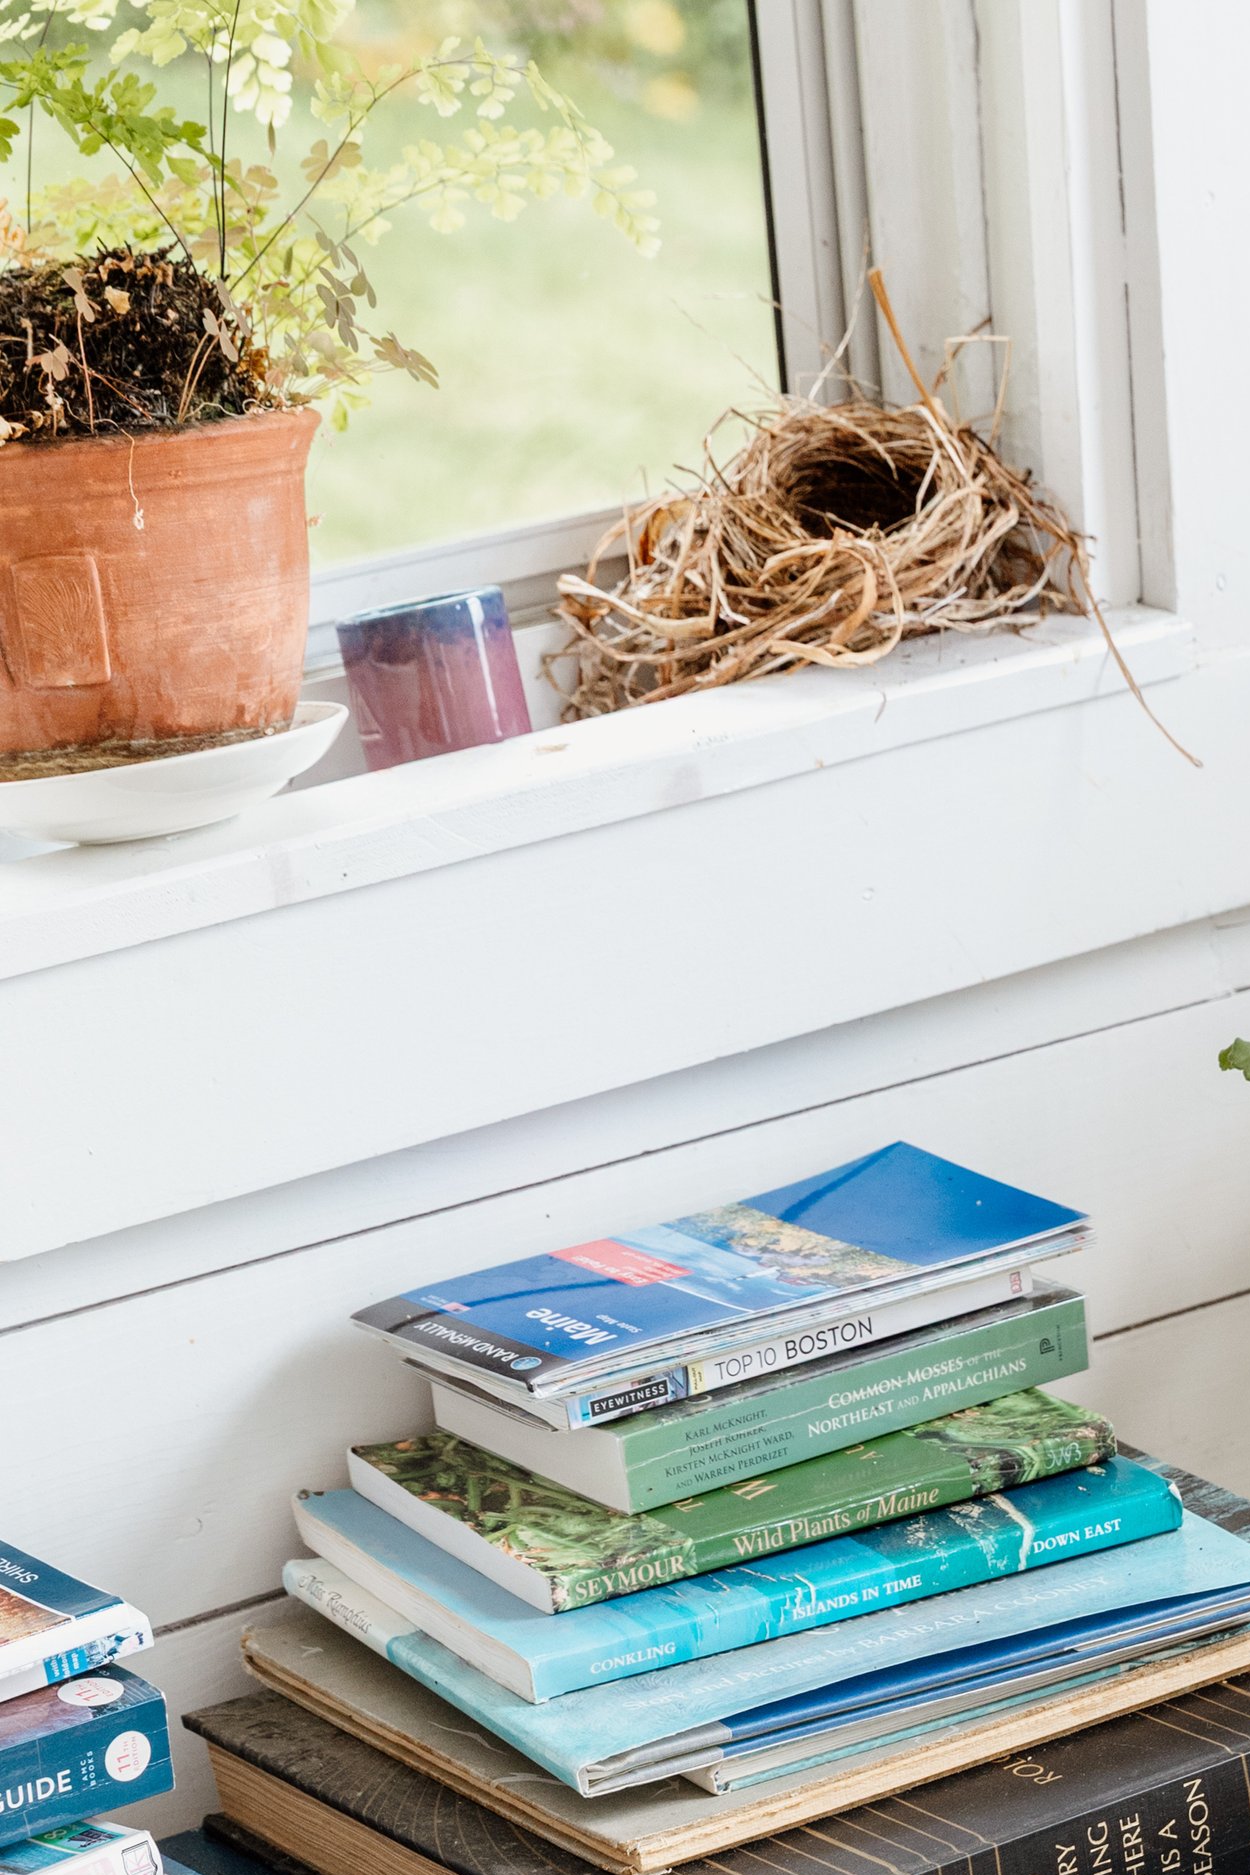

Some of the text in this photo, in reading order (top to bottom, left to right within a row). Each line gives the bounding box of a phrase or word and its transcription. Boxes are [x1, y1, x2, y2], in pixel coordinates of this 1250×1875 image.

[525, 1307, 617, 1347] Maine
[715, 1354, 754, 1381] TOP
[757, 1347, 777, 1369] 10
[783, 1316, 874, 1361] BOSTON
[473, 1339, 512, 1363] RAND
[592, 1382, 667, 1416] EYEWITNESS
[807, 1356, 1027, 1438] NORTHEAST AND APPALACHIANS
[828, 1377, 904, 1410] COMMON
[904, 1357, 965, 1390] MOSSES
[685, 1425, 709, 1443] KARL
[688, 1438, 721, 1457] JOSEPH
[664, 1458, 706, 1479] KIRSTEN
[675, 1447, 788, 1491] AND WARREN PERDRIZET
[574, 1486, 940, 1602] SEYMOUR Wild Plants of Maine
[298, 1573, 325, 1602] Miss
[589, 1641, 676, 1675] CONKLING
[792, 1592, 857, 1622] ISLANDS
[861, 1586, 881, 1604] IN
[884, 1574, 923, 1599] TIME
[1032, 1533, 1081, 1555] DOWN
[1084, 1518, 1122, 1542] EAST
[693, 1673, 734, 1695] and
[826, 1643, 857, 1661] by
[857, 1606, 991, 1651] BARBARA
[994, 1573, 1112, 1615] COONEY
[88, 1750, 97, 1787] BOOKS
[0, 1769, 73, 1812] UIDE
[1157, 1817, 1181, 1871] IS A
